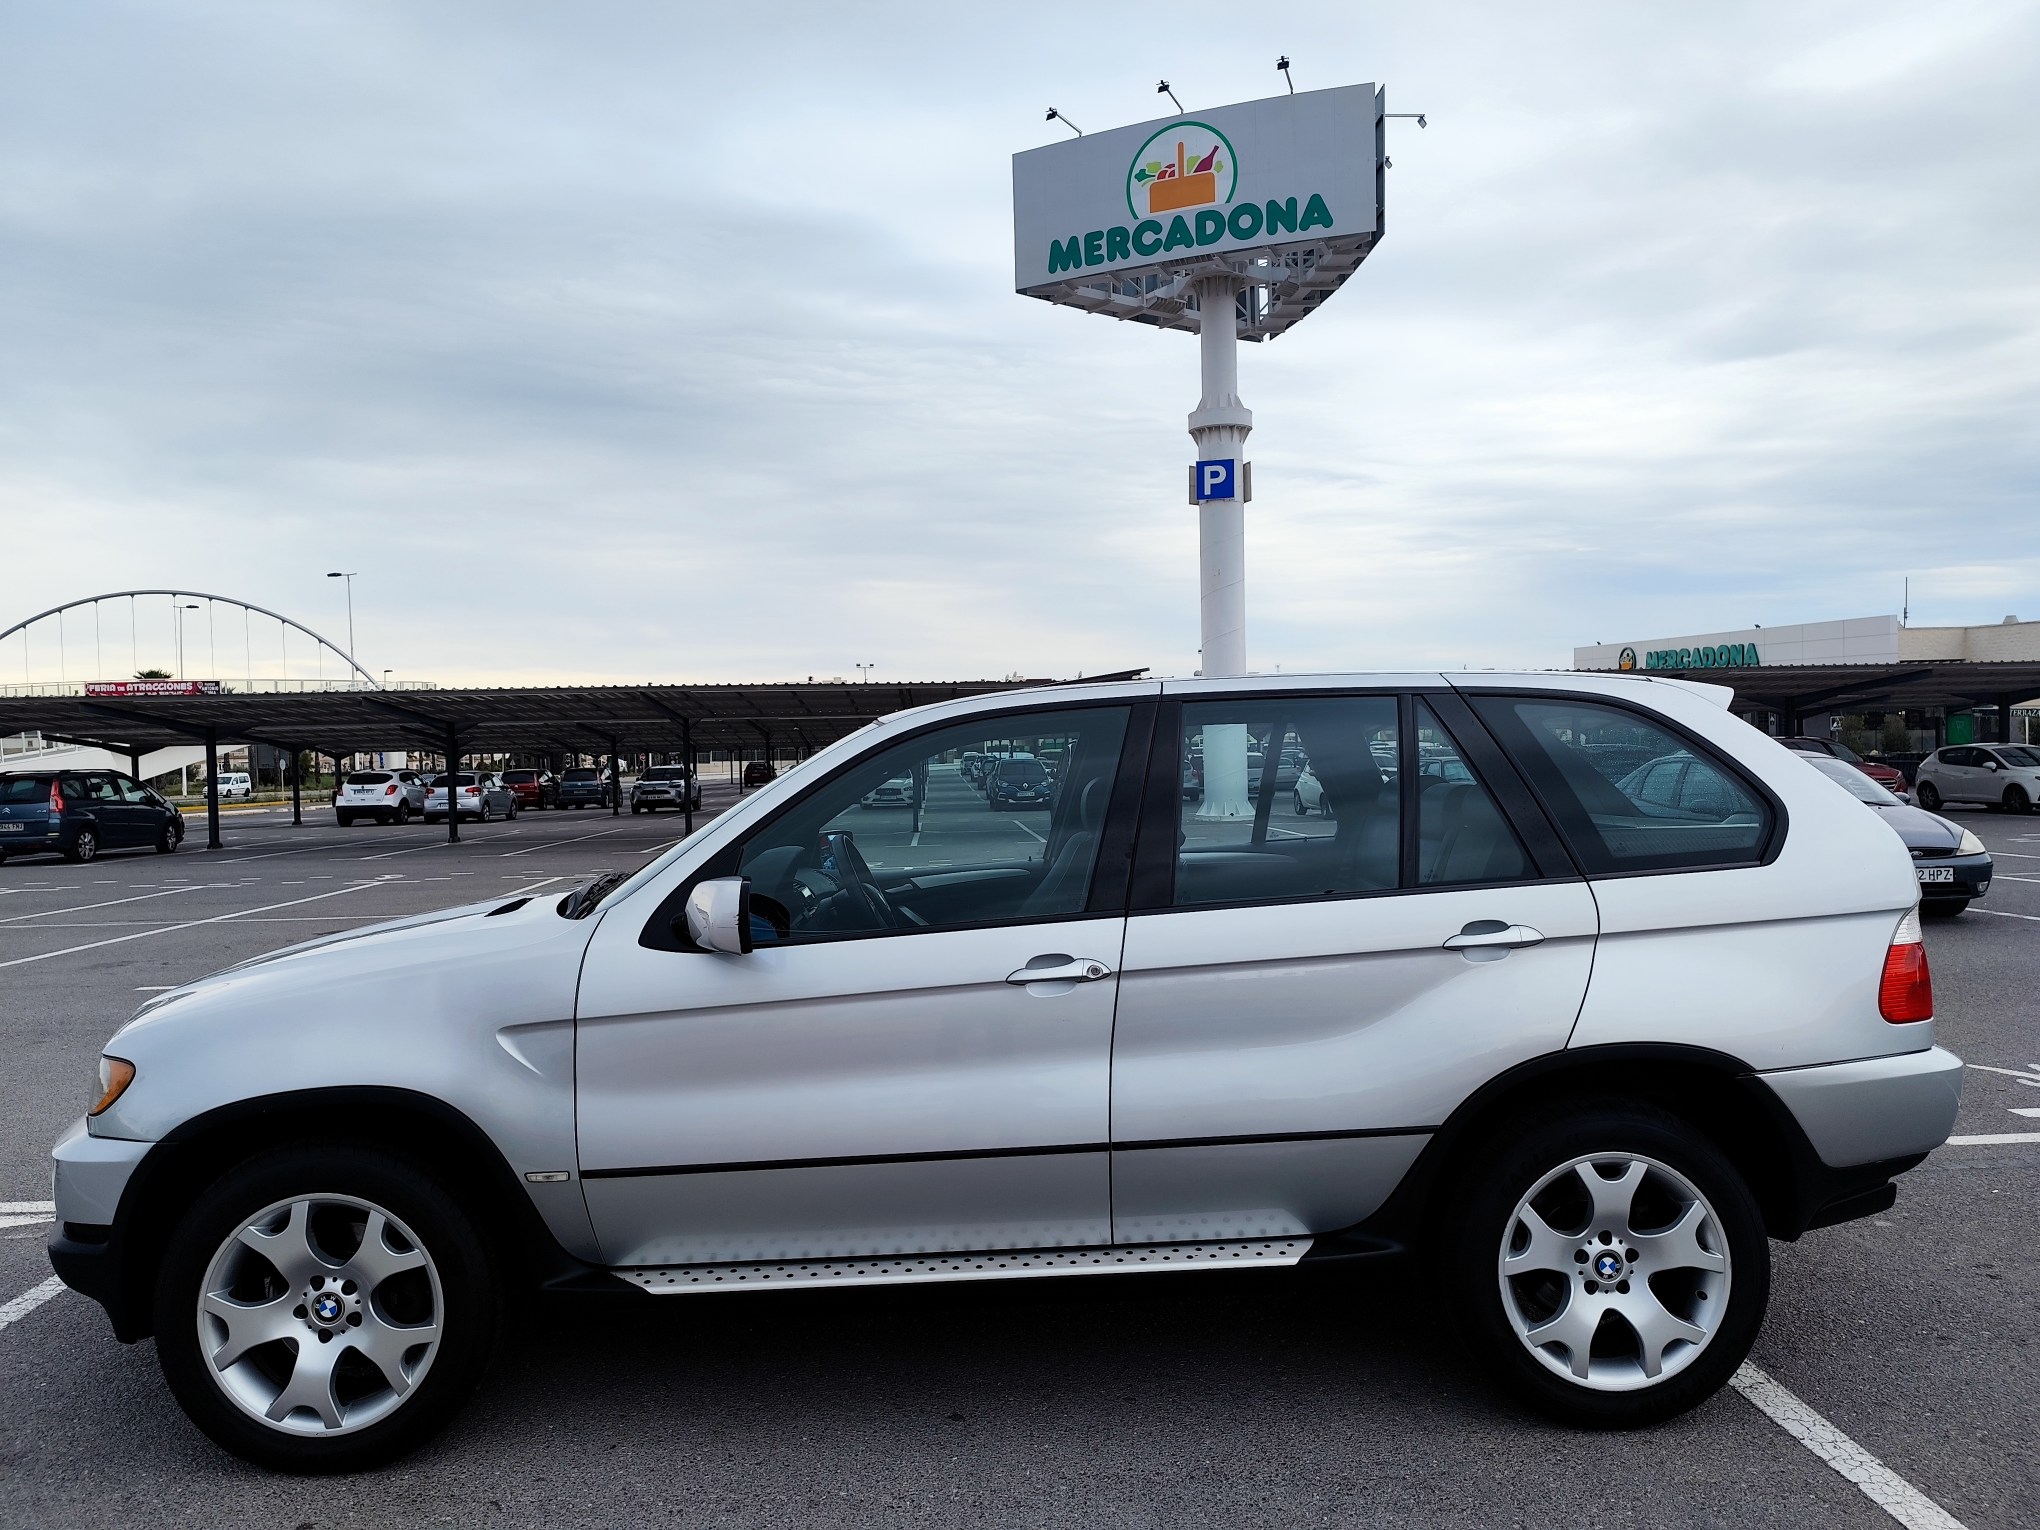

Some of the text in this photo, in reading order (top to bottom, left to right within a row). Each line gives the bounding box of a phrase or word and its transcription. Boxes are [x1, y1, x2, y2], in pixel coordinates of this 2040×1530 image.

[1048, 193, 1334, 274] MERCADONA
[1204, 465, 1227, 496] P
[1645, 642, 1760, 669] MERCADONA
[89, 684, 116, 692] FERIA
[126, 682, 193, 692] ATRACCIONES
[1928, 869, 1951, 881] HPZ
